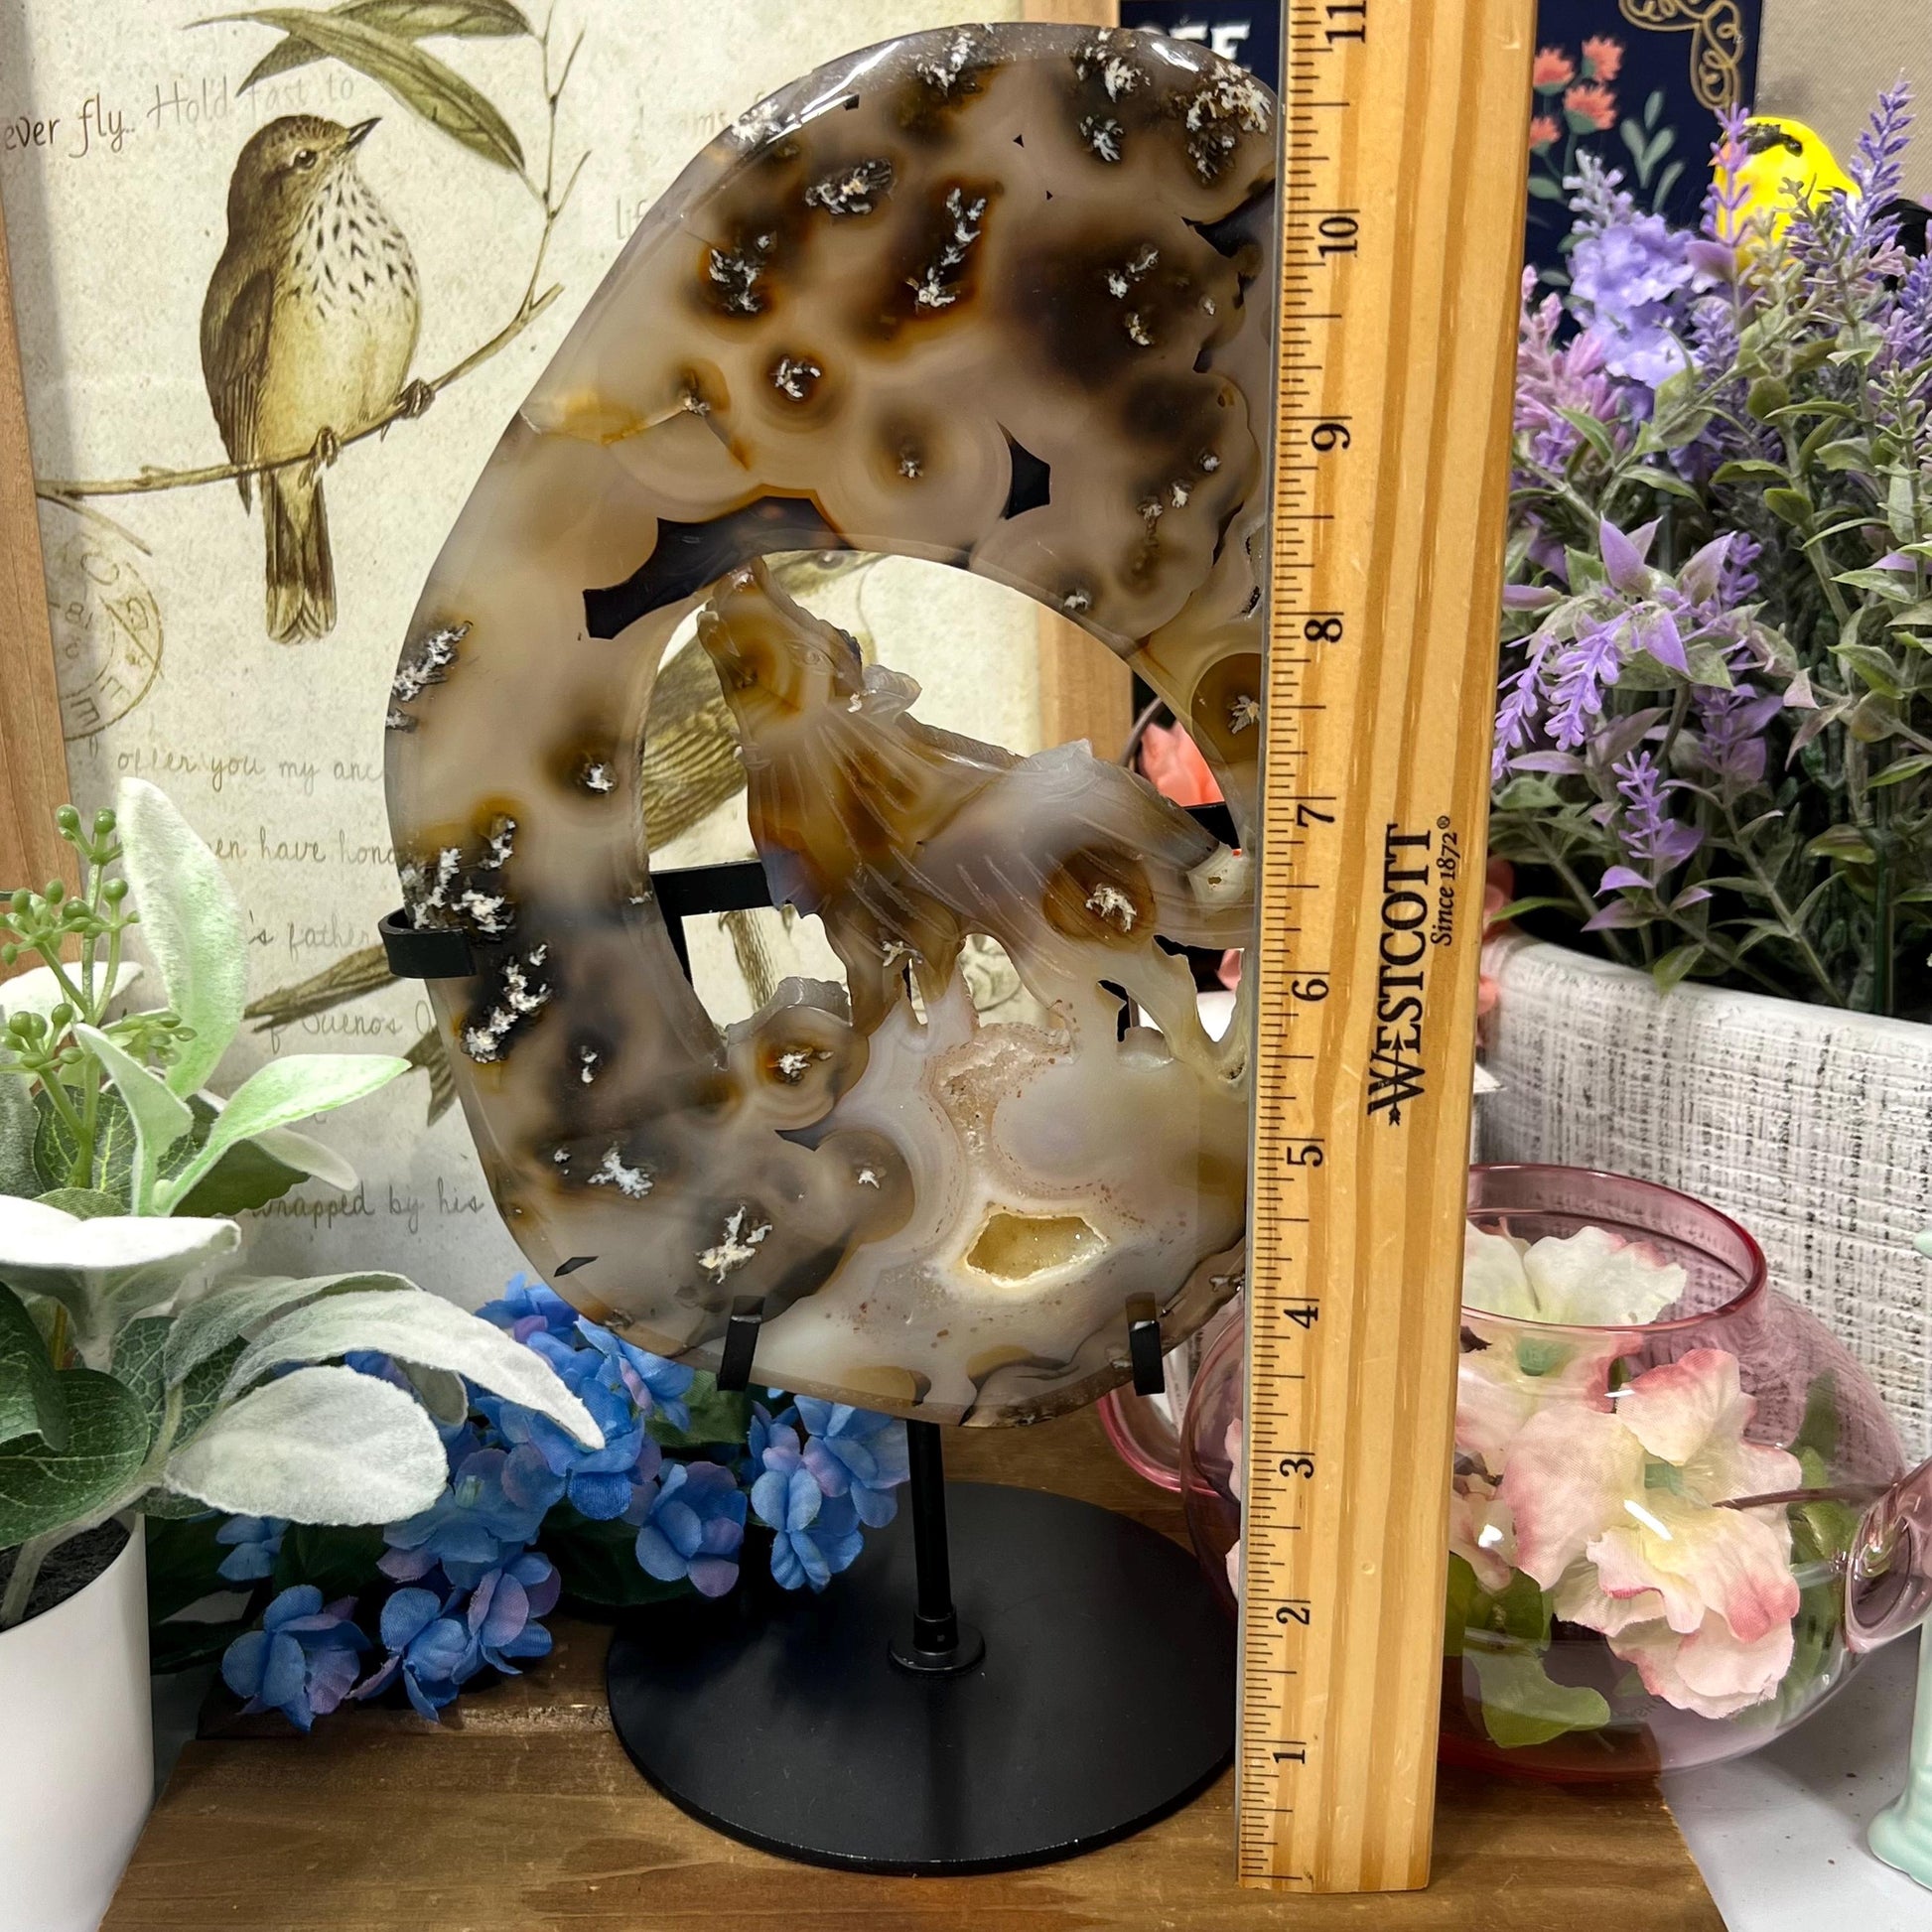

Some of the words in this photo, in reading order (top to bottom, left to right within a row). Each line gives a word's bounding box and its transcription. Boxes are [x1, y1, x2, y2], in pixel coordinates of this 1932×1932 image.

[1324, 0, 1367, 44] 11
[1317, 216, 1359, 258] 10
[1311, 423, 1351, 451] 9
[1304, 618, 1343, 643] 8
[210, 758, 264, 793] you
[279, 762, 321, 796] my
[1296, 803, 1335, 828] 7
[206, 838, 247, 860] en
[259, 825, 326, 863] have
[1431, 887, 1455, 947] Since
[1367, 822, 1432, 1116] WESTCOTT
[1291, 978, 1330, 1002] 6
[1286, 1145, 1323, 1168] 5
[389, 1184, 424, 1233] by
[438, 1176, 484, 1213] his
[1283, 1305, 1318, 1329] 4
[1279, 1458, 1315, 1479] 3
[1276, 1606, 1311, 1626] 2
[1273, 1749, 1307, 1765] 1
